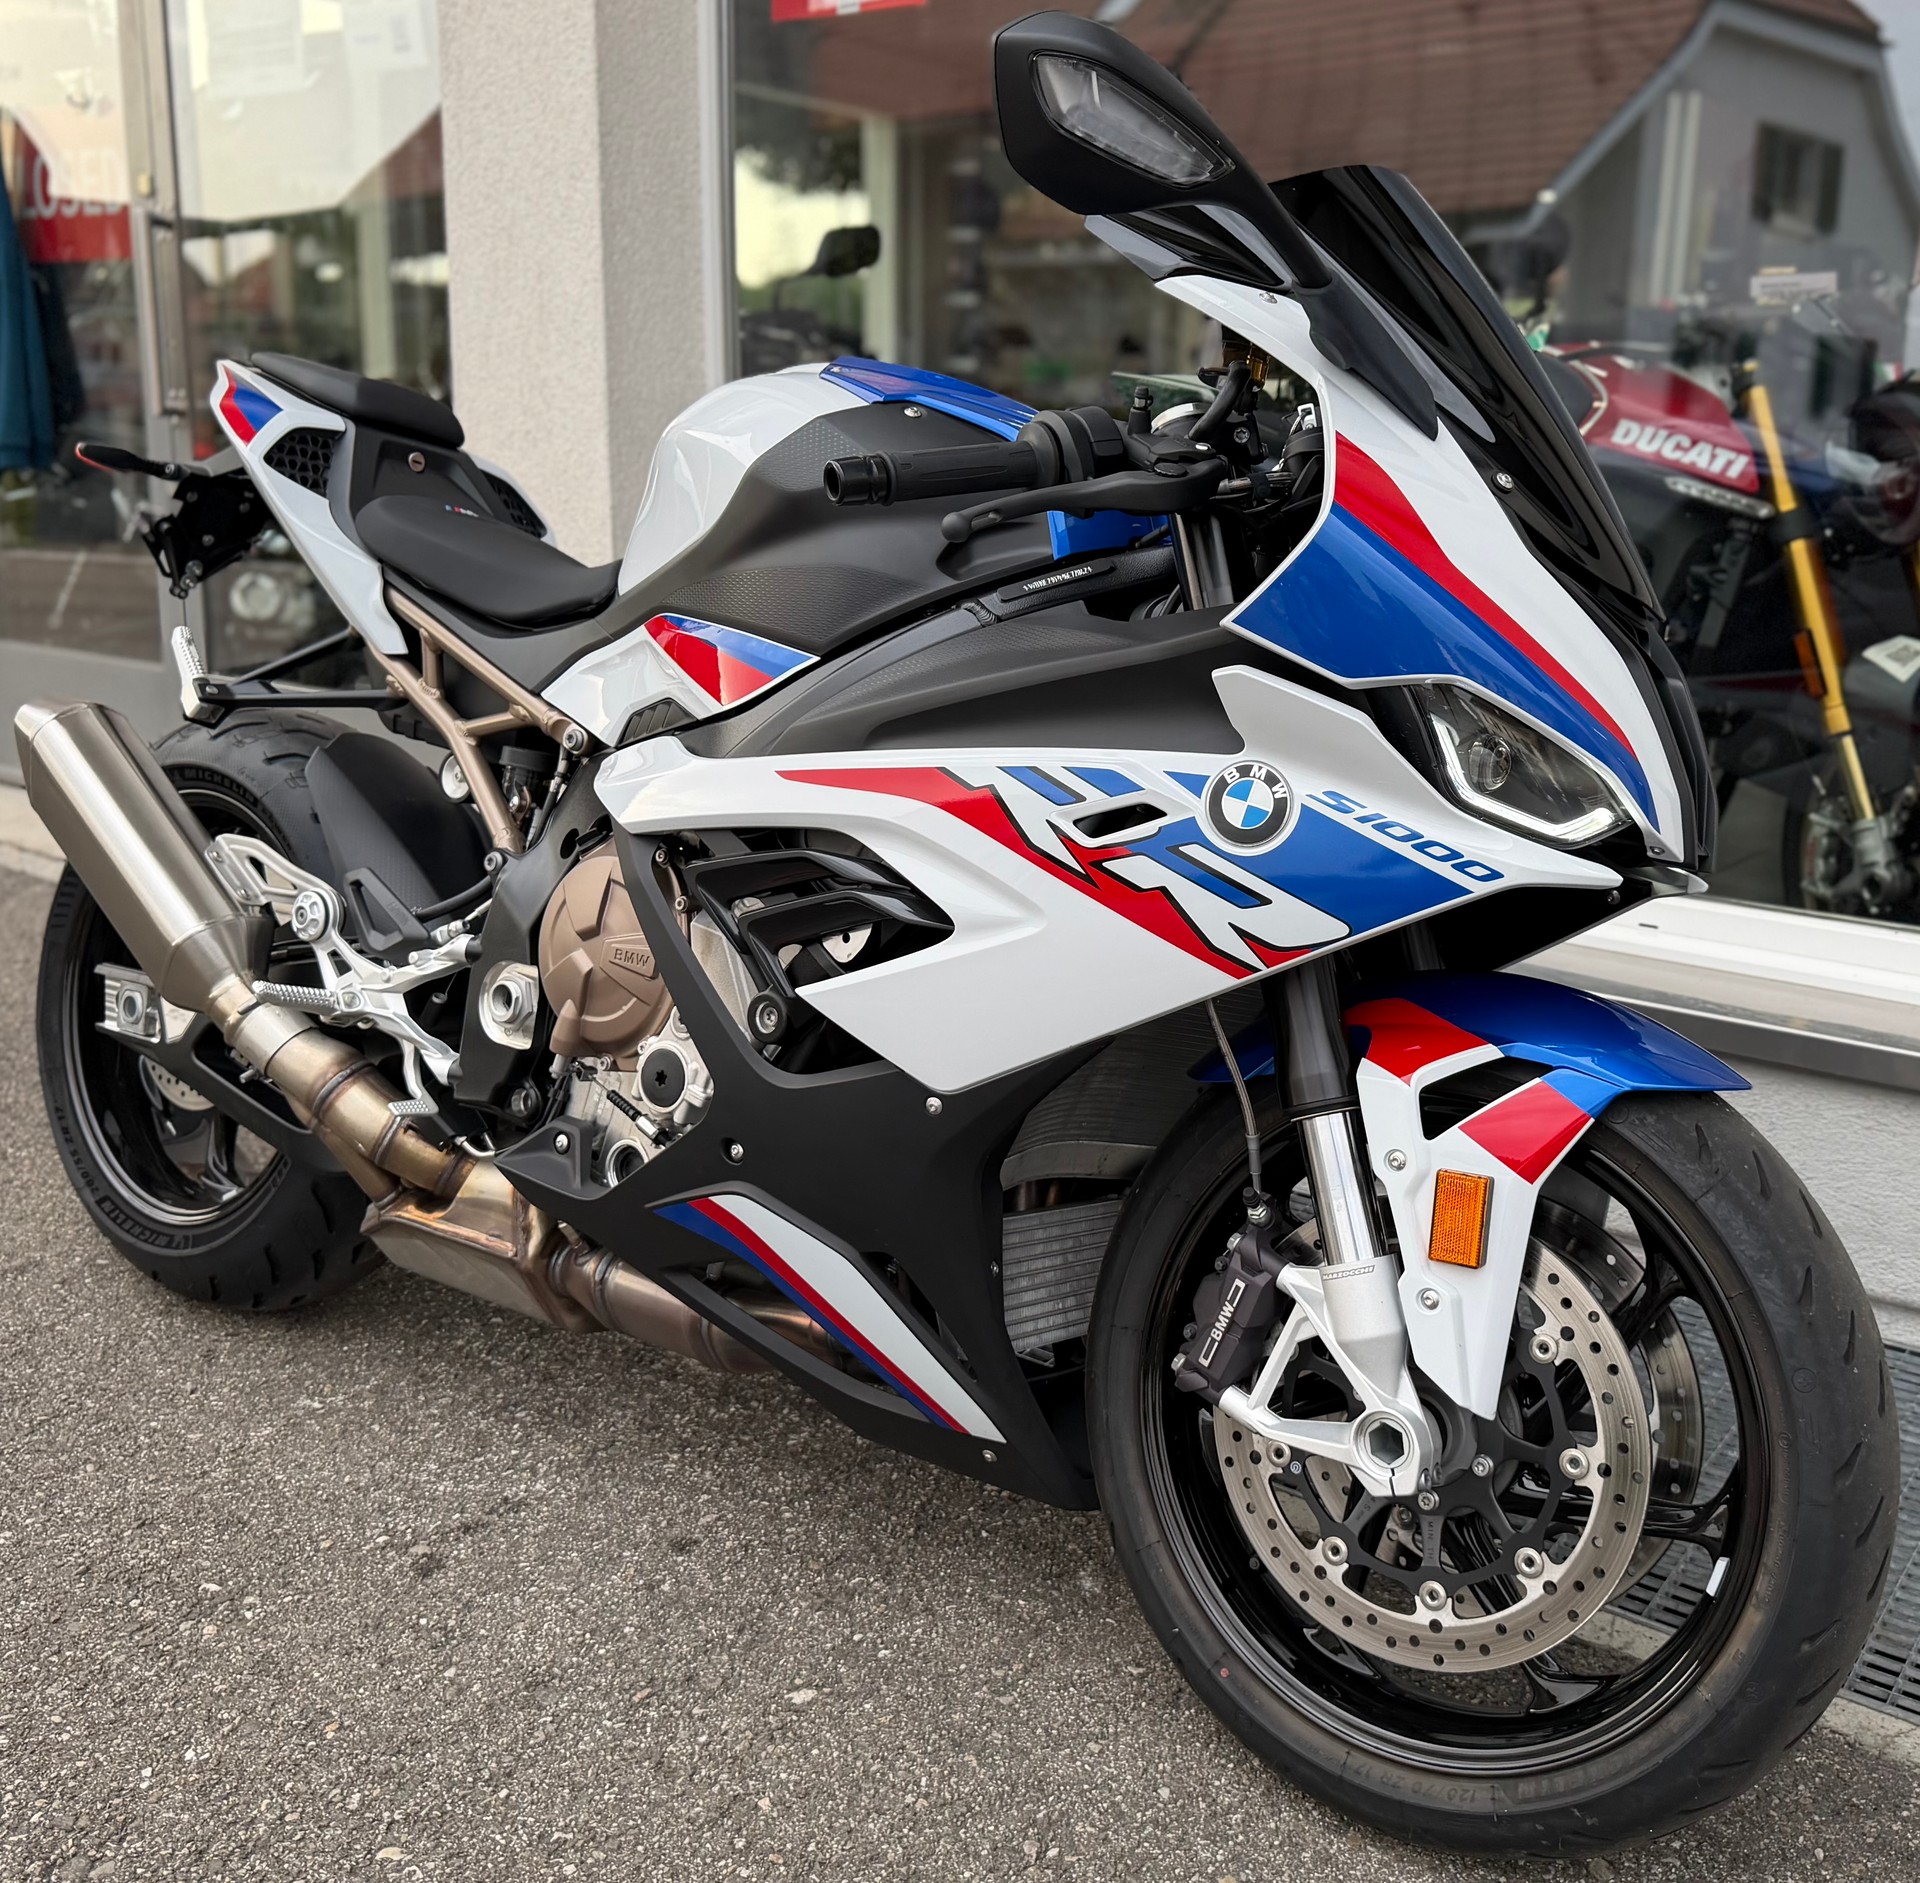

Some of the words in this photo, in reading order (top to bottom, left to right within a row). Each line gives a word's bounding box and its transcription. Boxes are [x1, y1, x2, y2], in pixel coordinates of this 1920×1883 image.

[15, 151, 124, 219] LOSED
[1610, 418, 1749, 479] DUCATI
[184, 767, 255, 805] MICHELIN
[1223, 764, 1287, 798] BMW
[1306, 790, 1505, 882] S1000
[613, 947, 651, 969] BMW
[69, 1148, 100, 1194] 200/55
[100, 1201, 170, 1247] MICHELIN
[1322, 1265, 1375, 1281] MARZOCCHI
[1209, 1301, 1235, 1342] BMW
[1352, 1763, 1375, 1778] 17
[1410, 1780, 1478, 1804] 120/70
